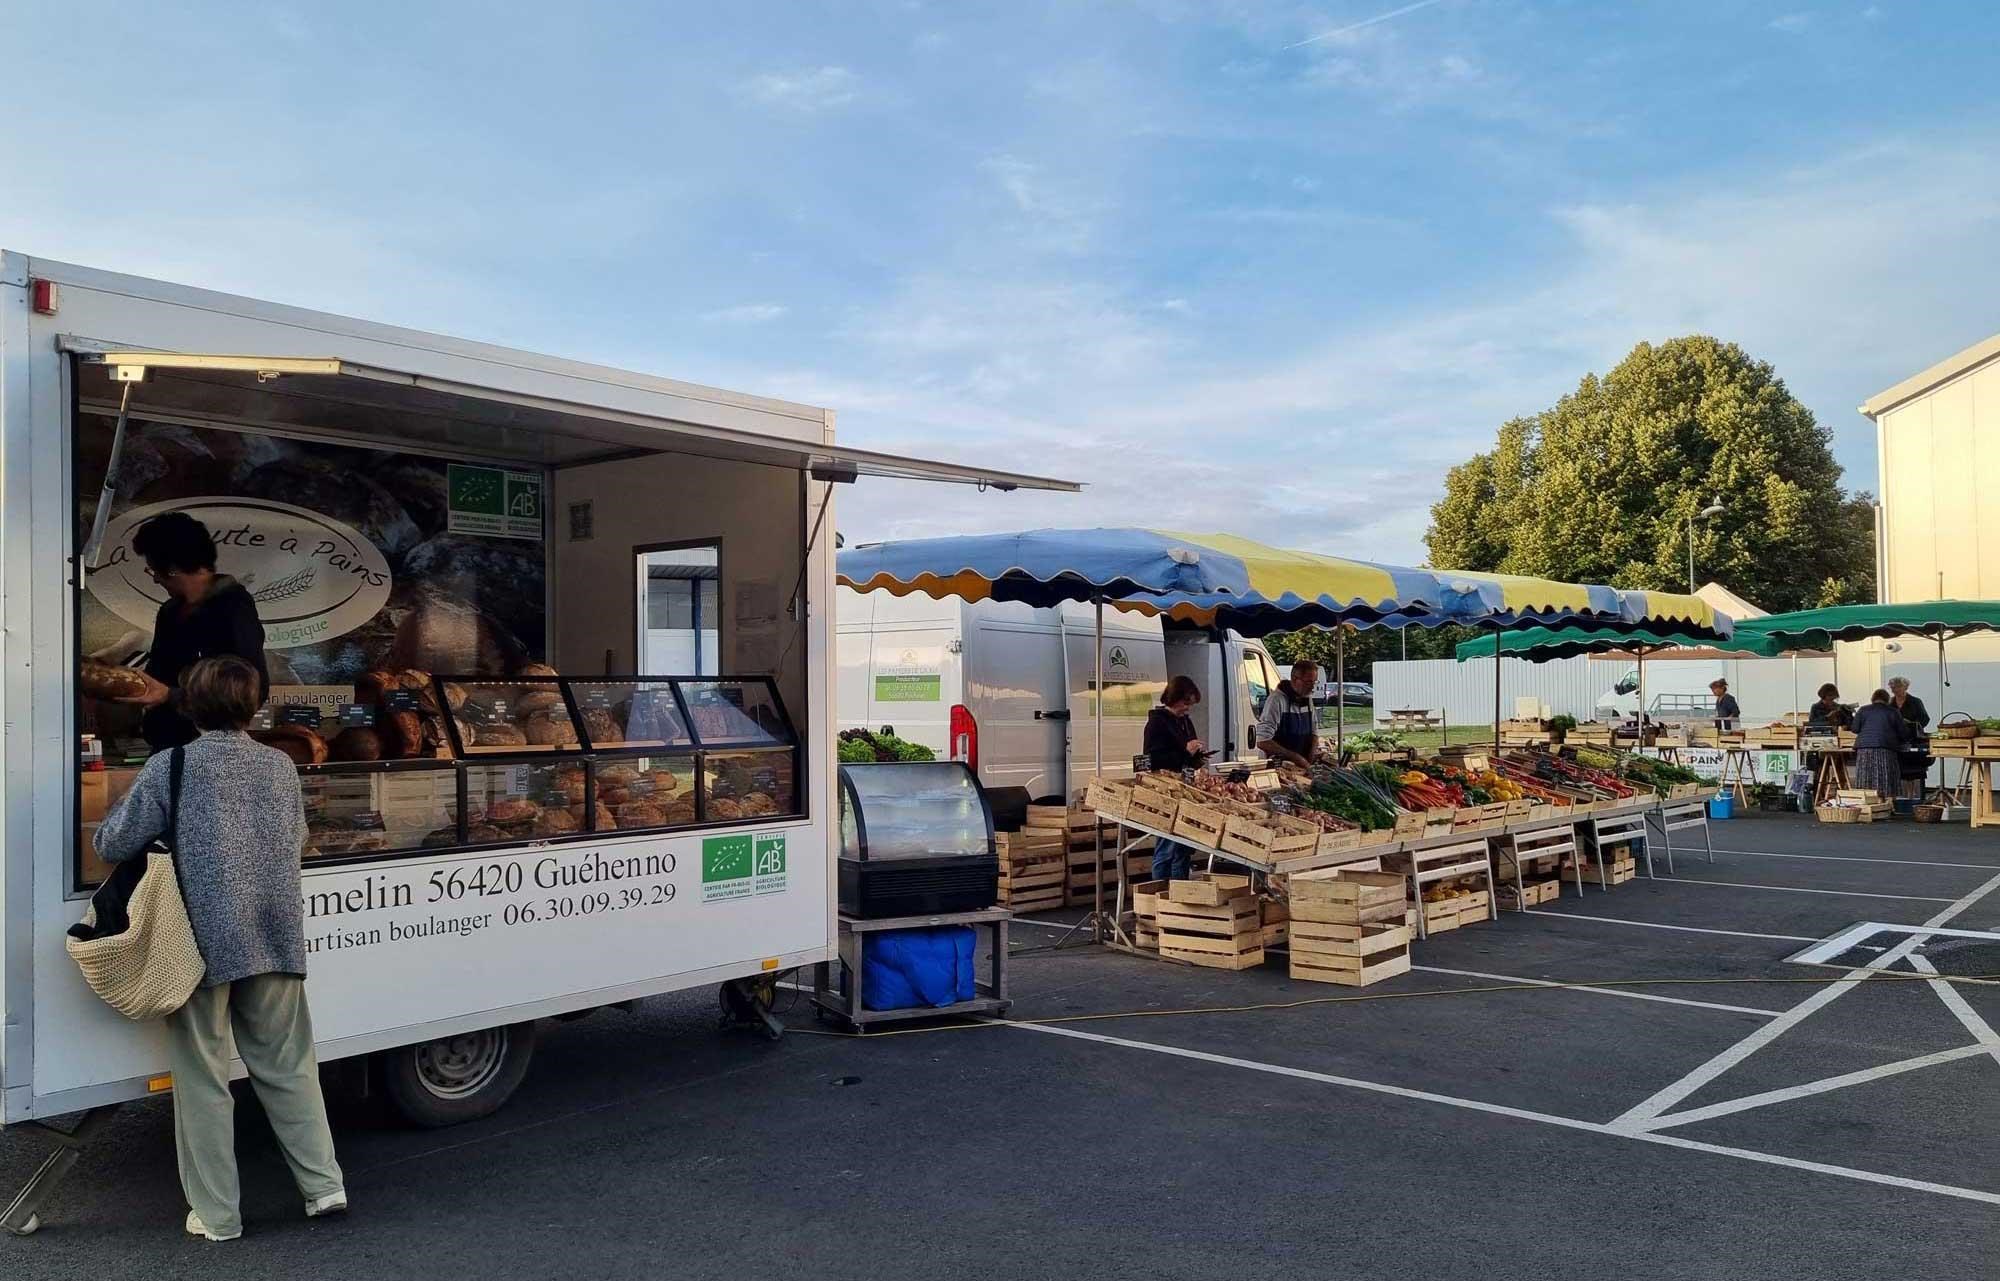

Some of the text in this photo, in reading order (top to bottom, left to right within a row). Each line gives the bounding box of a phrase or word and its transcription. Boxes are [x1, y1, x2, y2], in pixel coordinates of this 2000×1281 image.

[279, 528, 297, 555] à
[311, 540, 388, 587] Pains
[265, 620, 329, 644] ologique
[283, 691, 349, 707] boulanger
[1768, 759, 1786, 772] AB
[302, 852, 677, 918] melin 56420 Guéhenno
[389, 910, 493, 942] boulanger
[503, 882, 677, 926] 06.30.09.39.29
